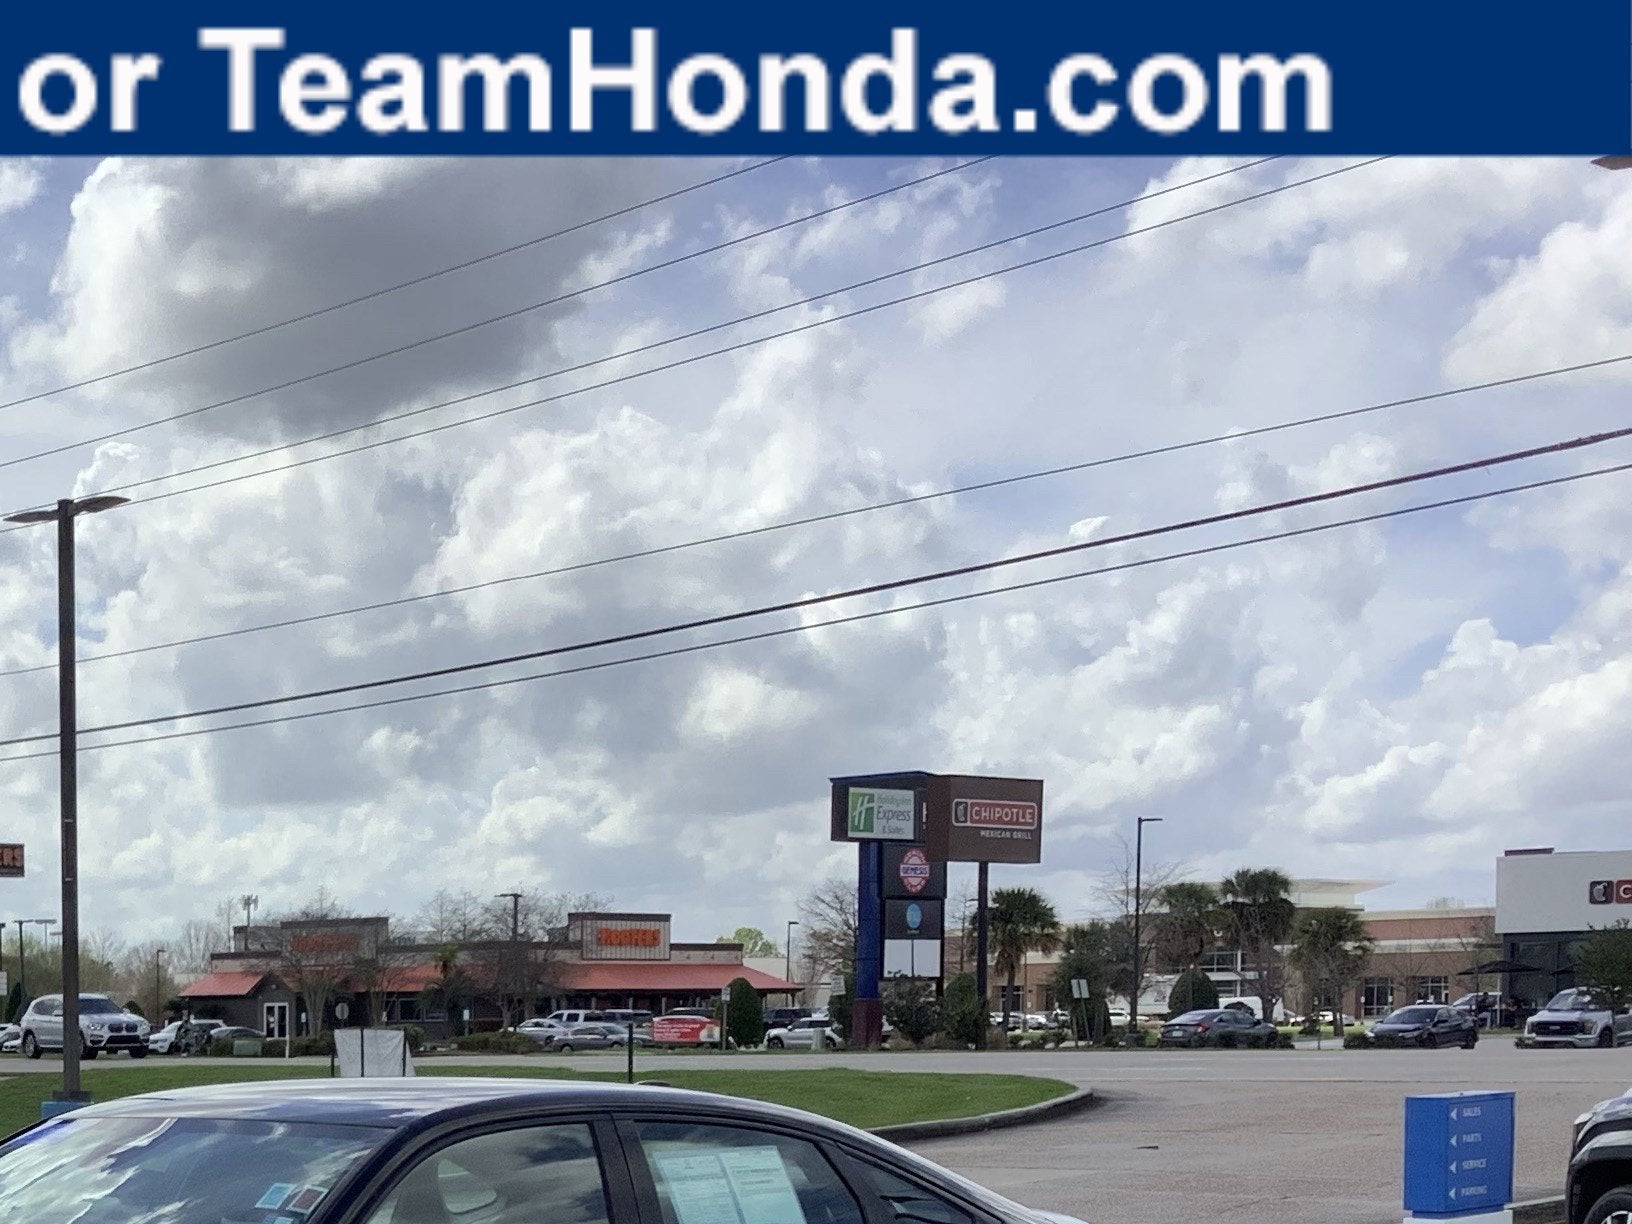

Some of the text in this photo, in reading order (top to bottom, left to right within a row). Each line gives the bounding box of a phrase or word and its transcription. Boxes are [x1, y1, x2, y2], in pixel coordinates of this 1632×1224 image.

[877, 806, 912, 824] Express
[972, 806, 1034, 823] CHIPOTLE
[980, 830, 1032, 840] MEXICAN GRILL
[1463, 1107, 1481, 1117] SALES
